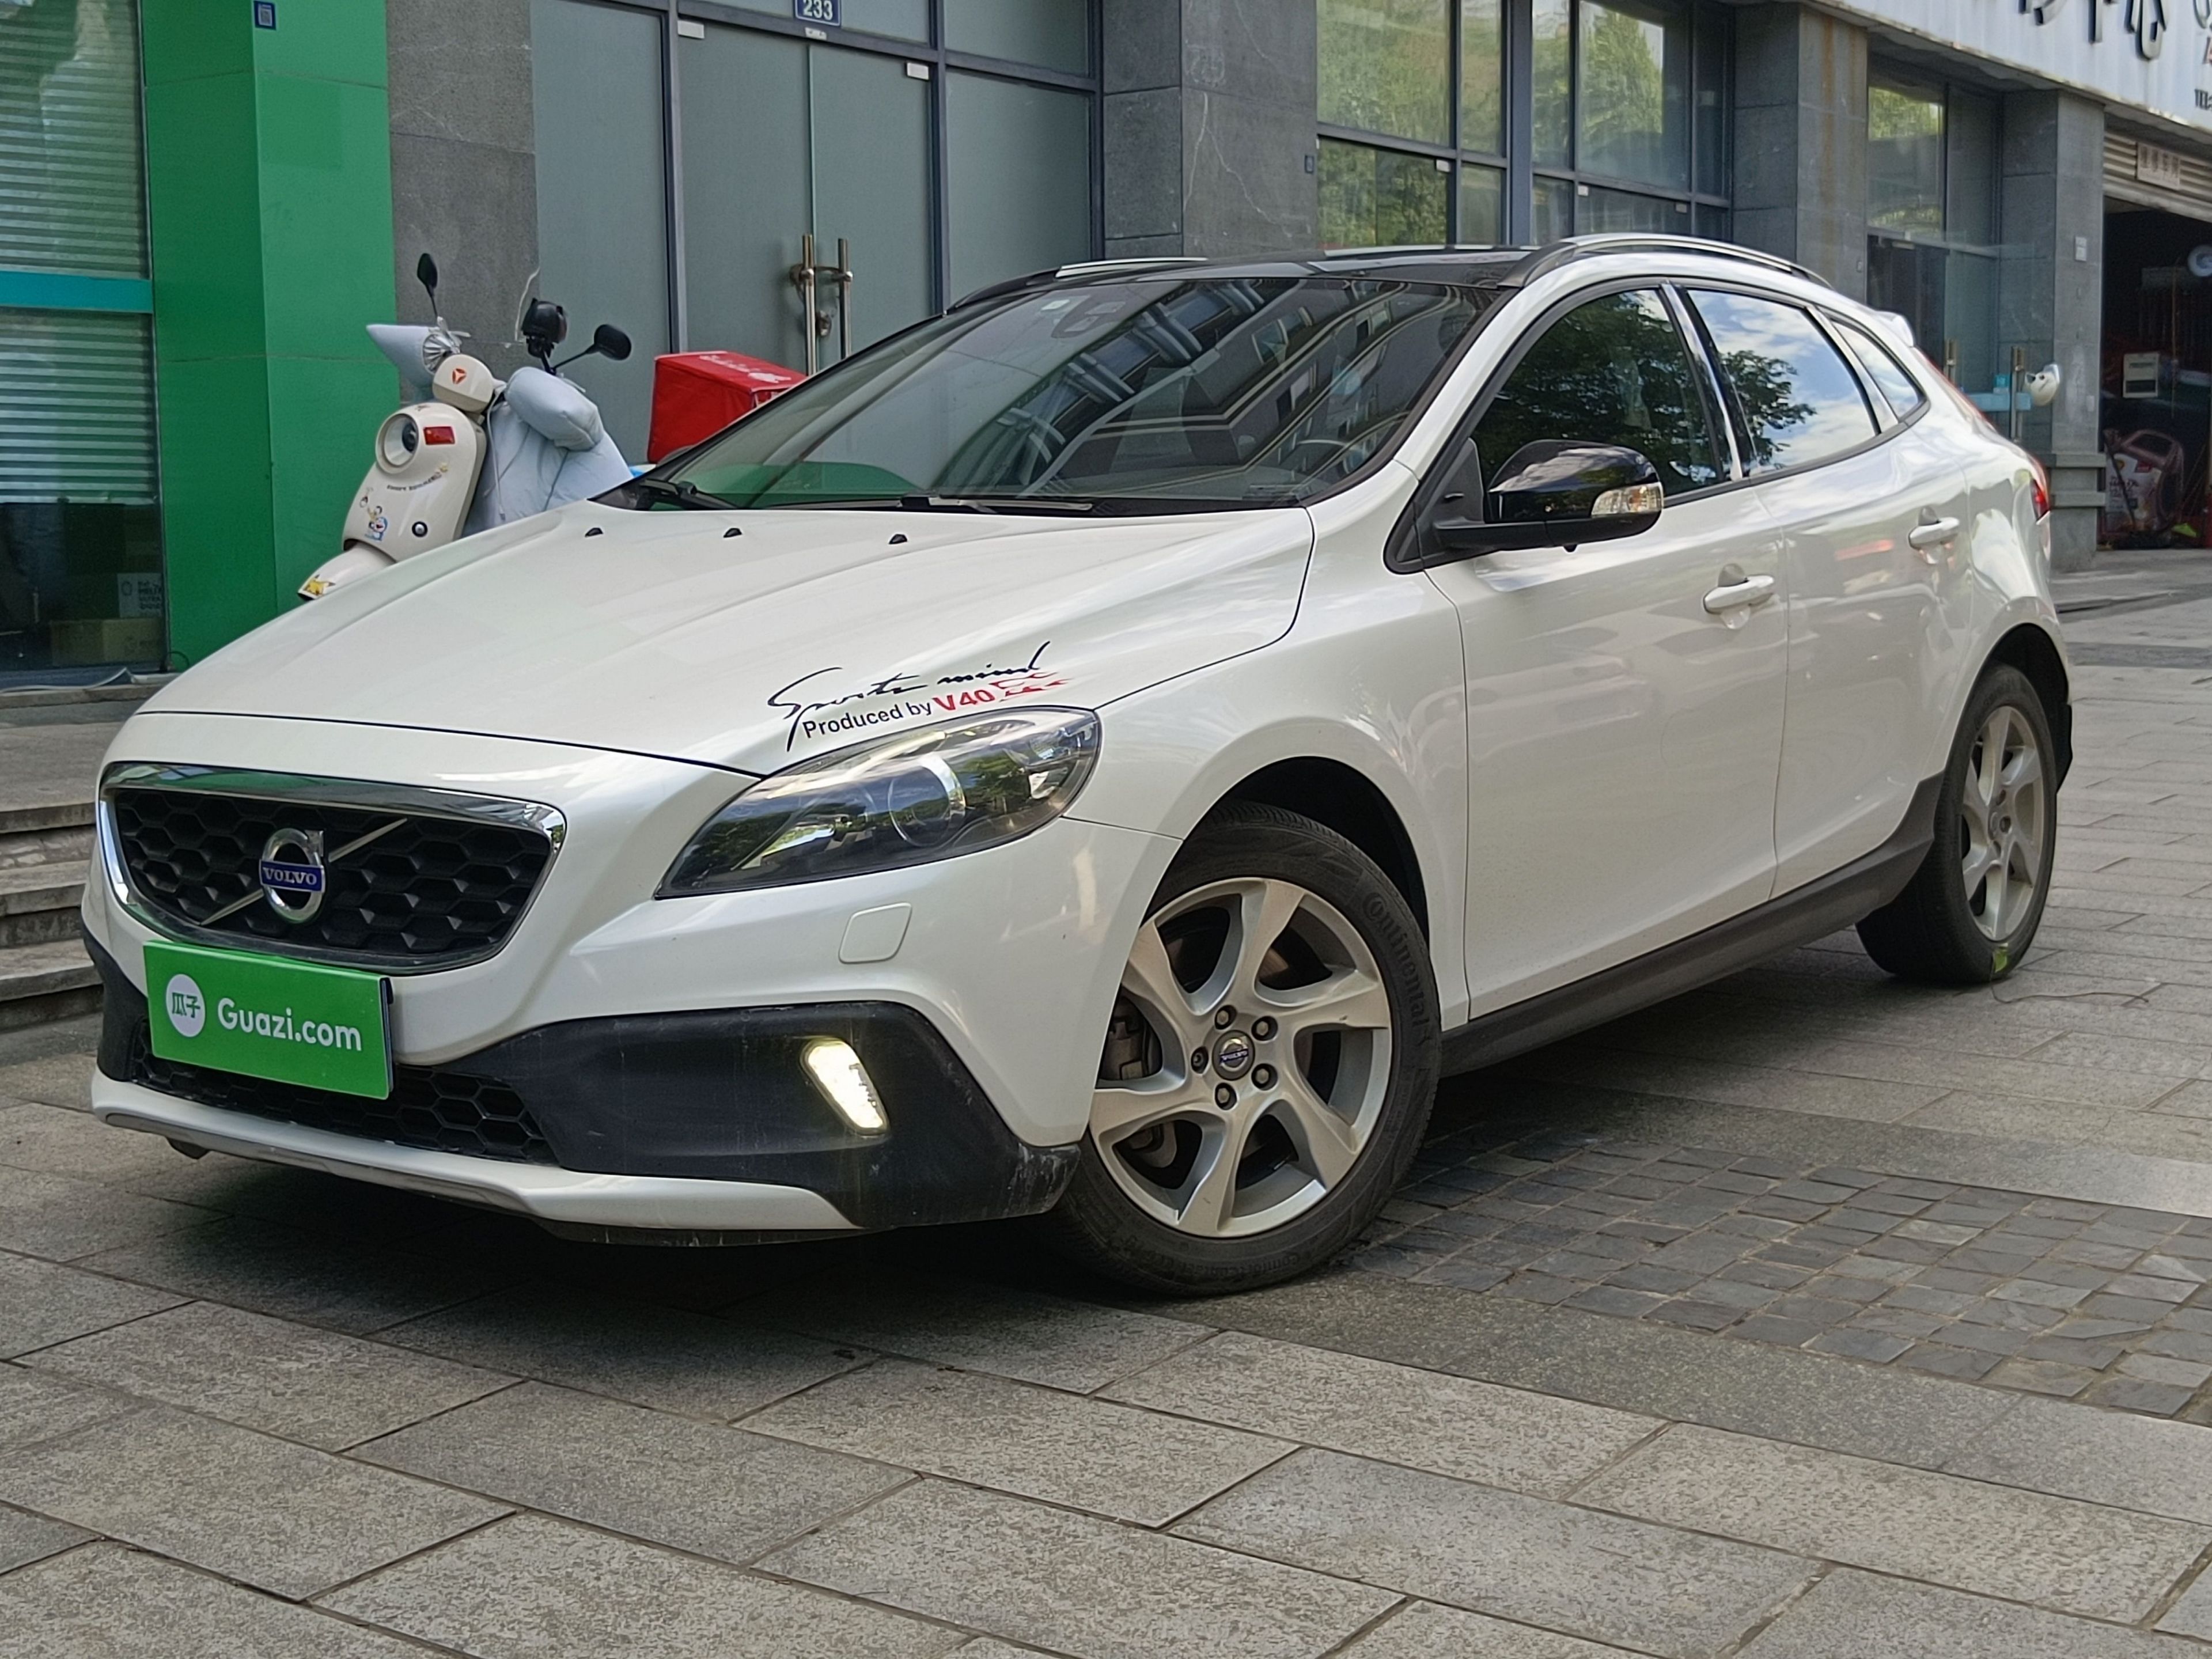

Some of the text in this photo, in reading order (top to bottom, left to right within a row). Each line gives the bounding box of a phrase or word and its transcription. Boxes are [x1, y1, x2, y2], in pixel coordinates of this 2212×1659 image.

[803, 0, 833, 20] 233
[802, 690, 995, 738] Produced by V40
[262, 866, 317, 885] VOLVO
[172, 992, 201, 1018] 瓜子
[217, 997, 362, 1051] Guazi.com
